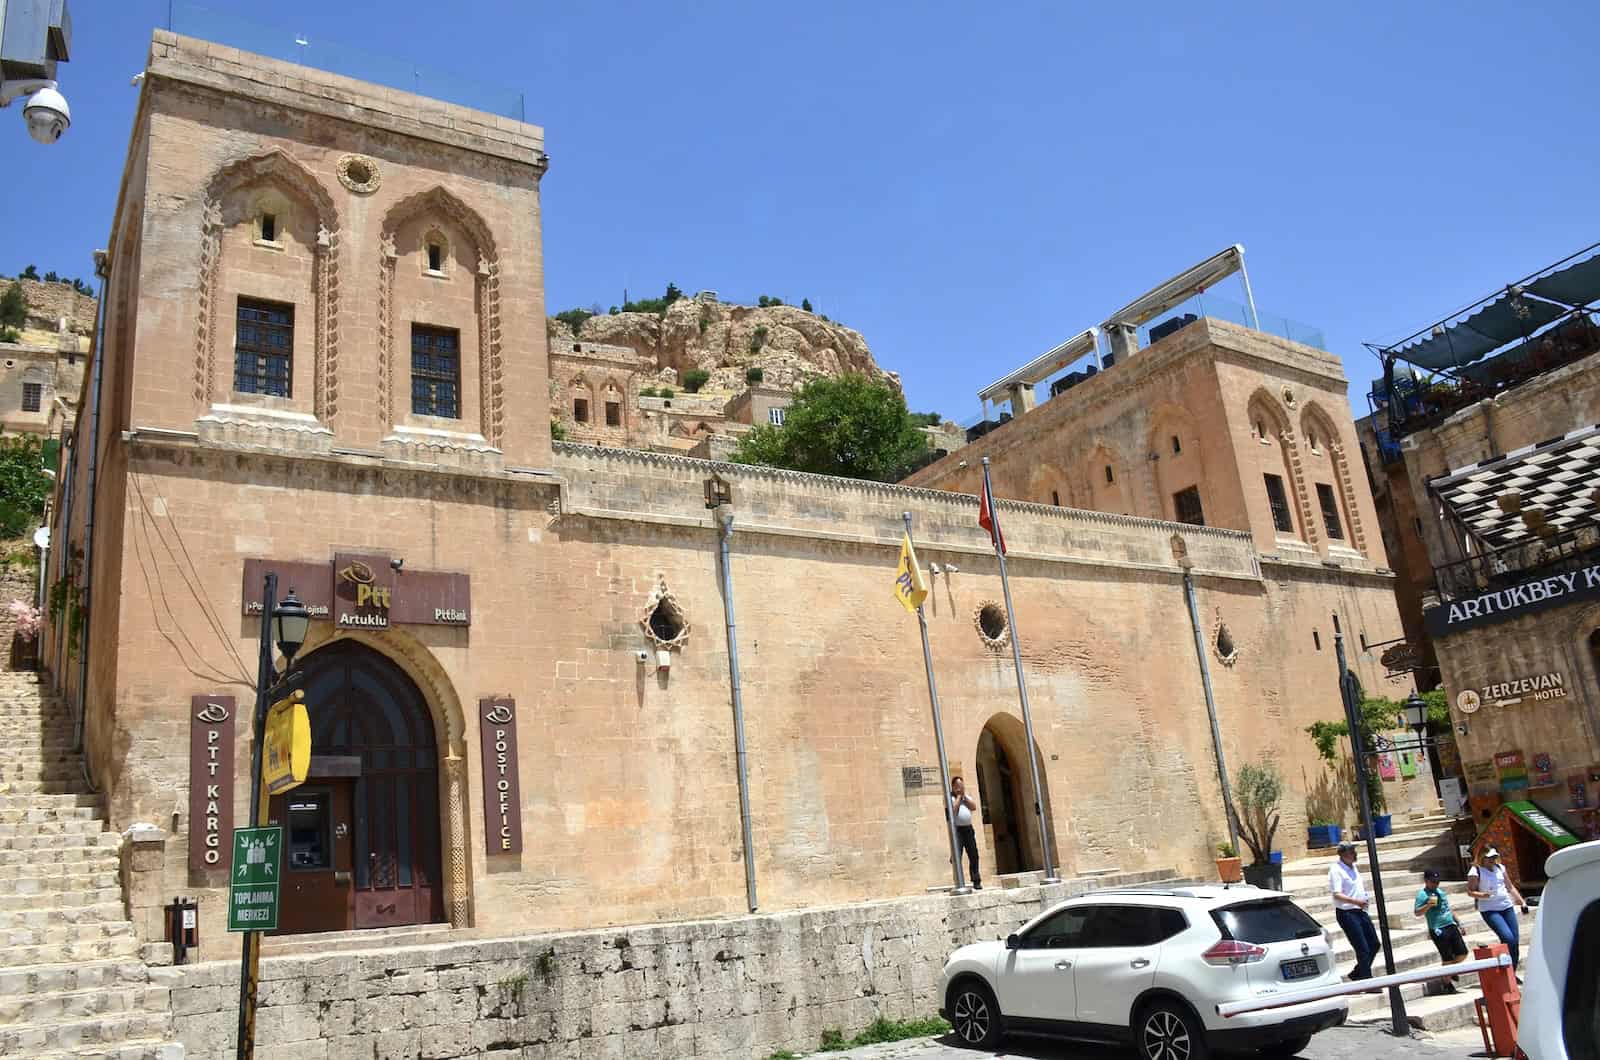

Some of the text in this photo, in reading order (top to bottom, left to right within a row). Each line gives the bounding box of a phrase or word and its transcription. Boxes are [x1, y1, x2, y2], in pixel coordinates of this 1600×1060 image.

[357, 583, 391, 609] Ptt
[1448, 572, 1577, 624] ARTUKBEY
[340, 612, 387, 627] Artuklu
[1482, 672, 1562, 700] ZERZEVAN
[1535, 688, 1567, 701] HOTEL
[205, 730, 220, 864] PTT KARGO
[495, 729, 512, 850] POST OFFICE
[234, 891, 274, 905] TOPLANMA
